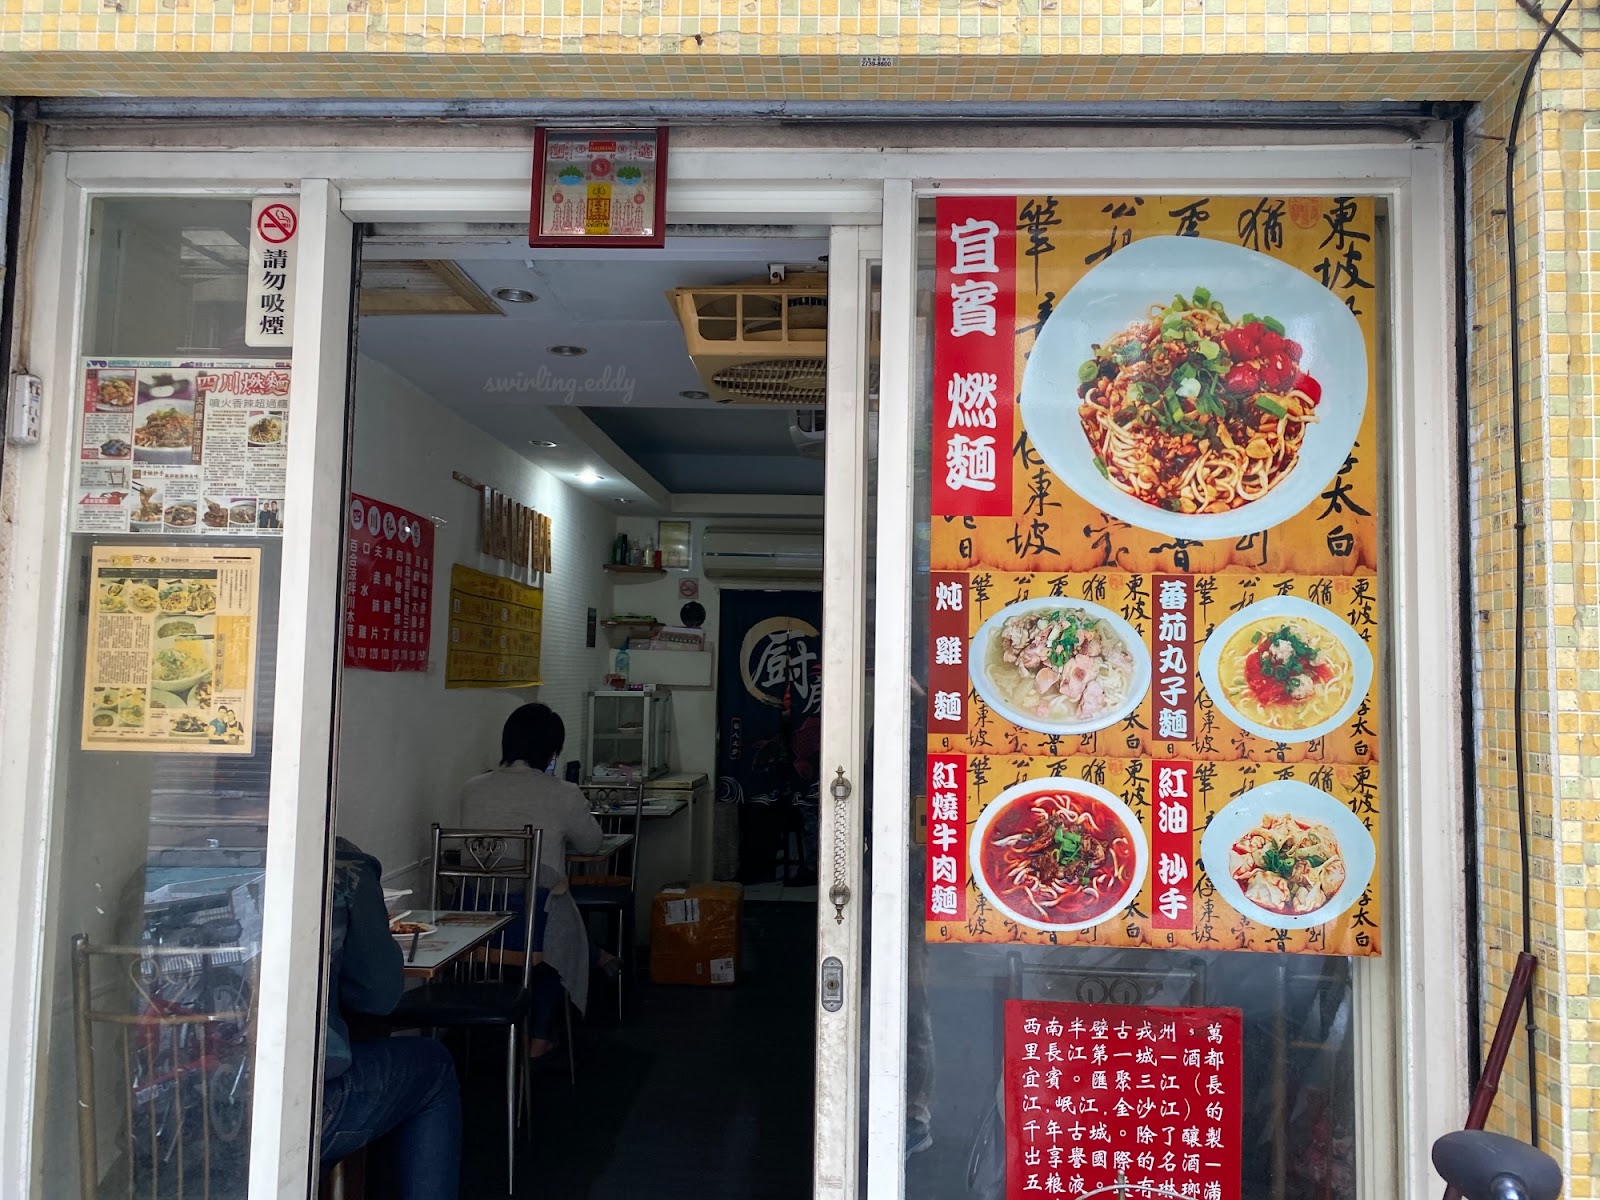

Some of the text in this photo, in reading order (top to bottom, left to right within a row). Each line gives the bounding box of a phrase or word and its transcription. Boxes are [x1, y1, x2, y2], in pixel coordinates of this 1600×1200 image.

[260, 248, 287, 336] 請勿吸煙
[947, 216, 1001, 492] 宜賓 燃麵
[196, 371, 290, 396] 四川燃麵
[933, 580, 963, 722] 炖雞麵
[1158, 579, 1188, 740] 蕃茄丸子麵
[930, 761, 959, 914] 紅燒牛肉麵
[1158, 766, 1188, 920] 紅油 抄手
[1022, 1120, 1225, 1149] 千年古城。除了釀製
